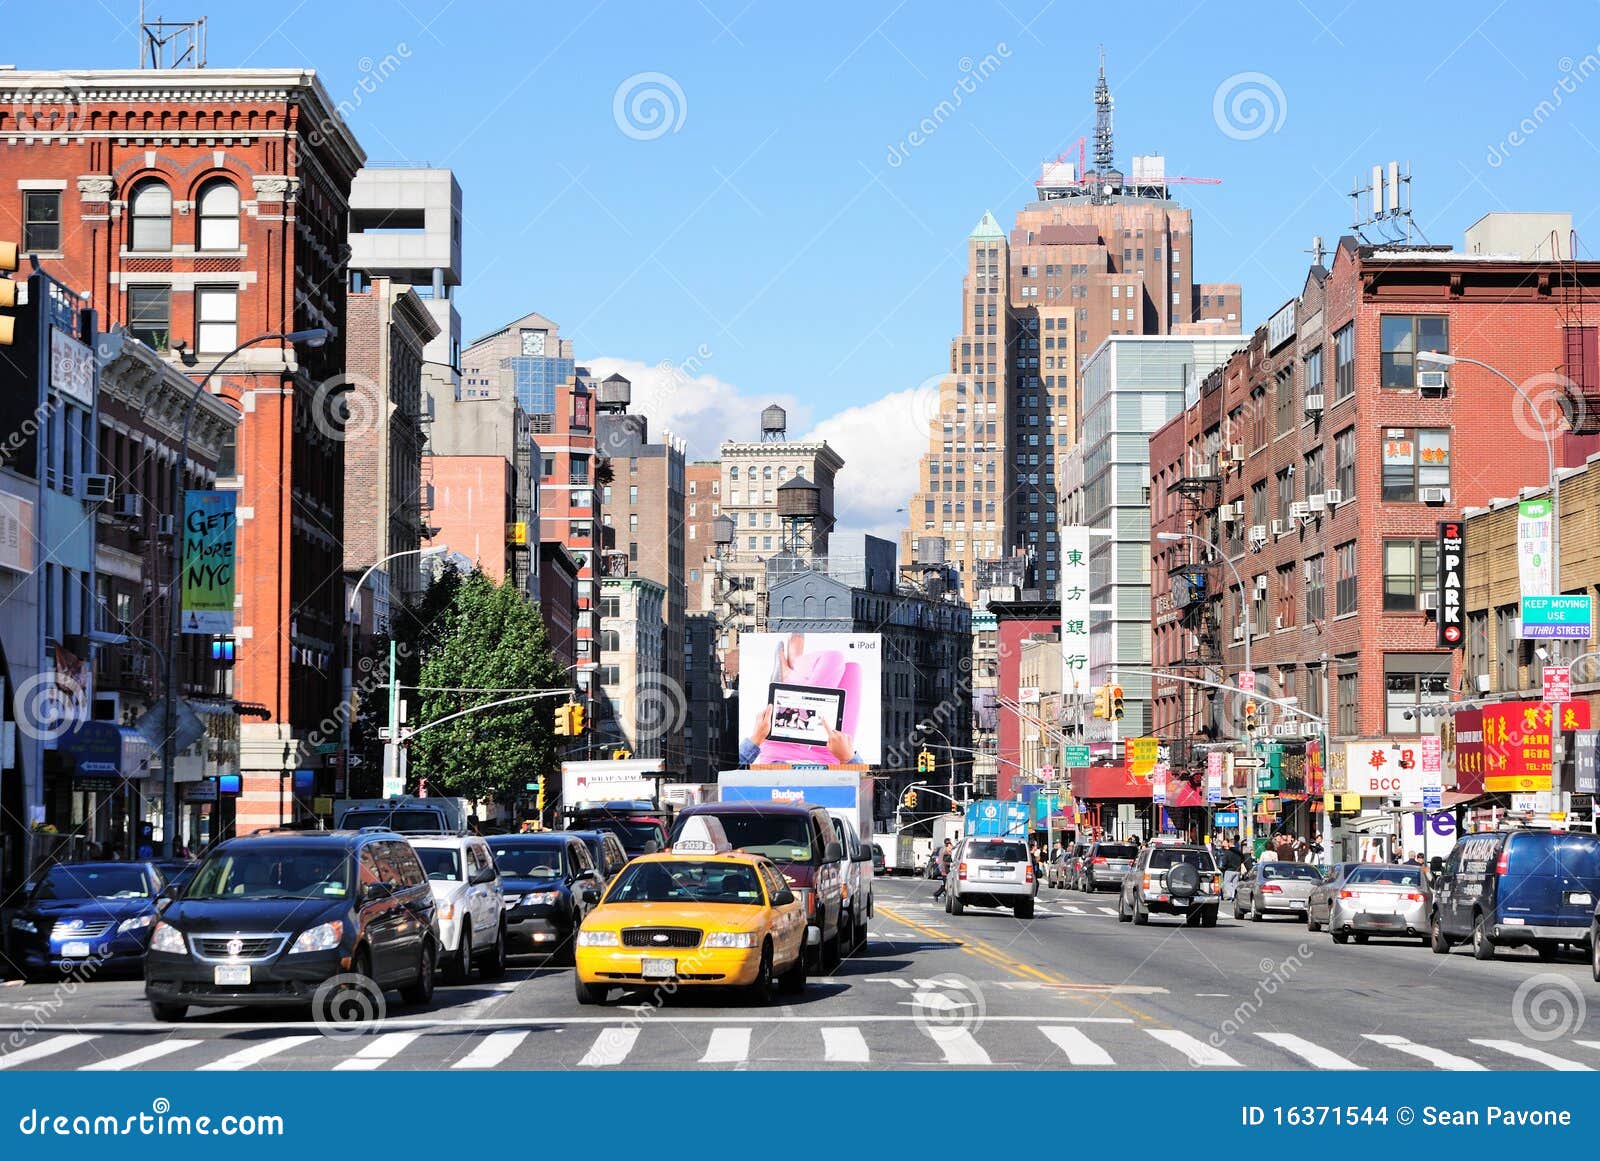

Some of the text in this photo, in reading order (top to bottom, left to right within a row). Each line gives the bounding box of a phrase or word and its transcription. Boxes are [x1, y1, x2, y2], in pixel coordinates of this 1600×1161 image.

[187, 509, 234, 536] GET
[186, 539, 233, 560] MORE
[188, 564, 232, 591] NYC
[1445, 555, 1461, 623] PARK
[1066, 549, 1088, 670] 東方銀行
[1525, 600, 1589, 608] KEEP MOVING!
[1547, 611, 1566, 620] USE
[1534, 626, 1590, 635] THRU STREETS
[857, 641, 876, 649] iPad
[1370, 778, 1400, 790] BCC
[771, 789, 805, 800] Budget
